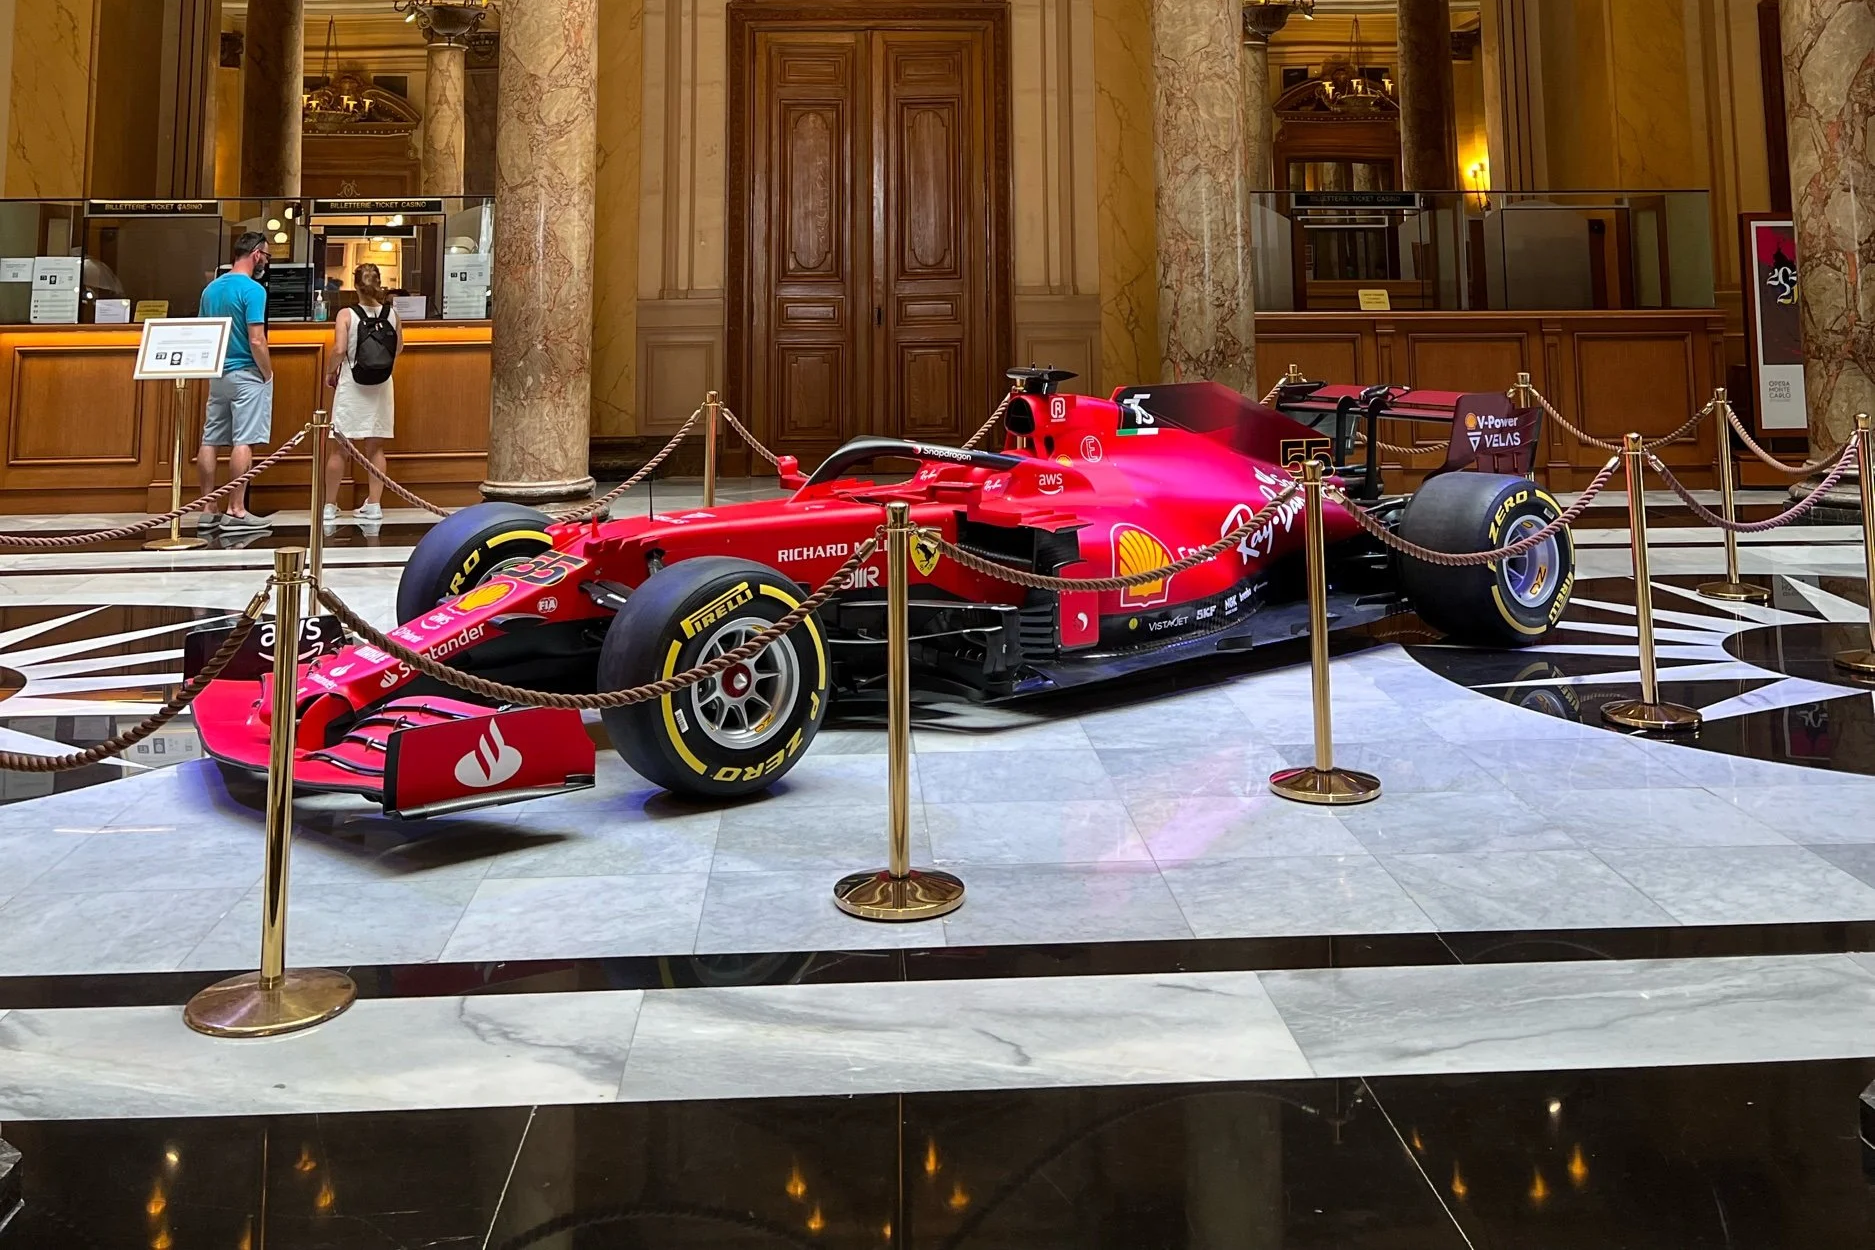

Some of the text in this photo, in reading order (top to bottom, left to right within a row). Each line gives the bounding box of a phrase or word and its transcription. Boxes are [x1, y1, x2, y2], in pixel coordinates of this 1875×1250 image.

[1477, 414, 1519, 429] V-Power
[1484, 431, 1521, 448] VELAS
[923, 445, 972, 462] Snapdragon
[1280, 438, 1335, 479] 55
[1038, 472, 1063, 486] aws
[1488, 490, 1528, 545] ZERO
[777, 543, 848, 563] RICHARD
[501, 549, 588, 587] 55
[538, 597, 557, 613] FIA
[680, 581, 754, 640] PIRELLI
[1196, 605, 1217, 621] SKF
[260, 617, 321, 648] as
[398, 623, 485, 678] Sntander
[713, 691, 820, 783] P ZERO
